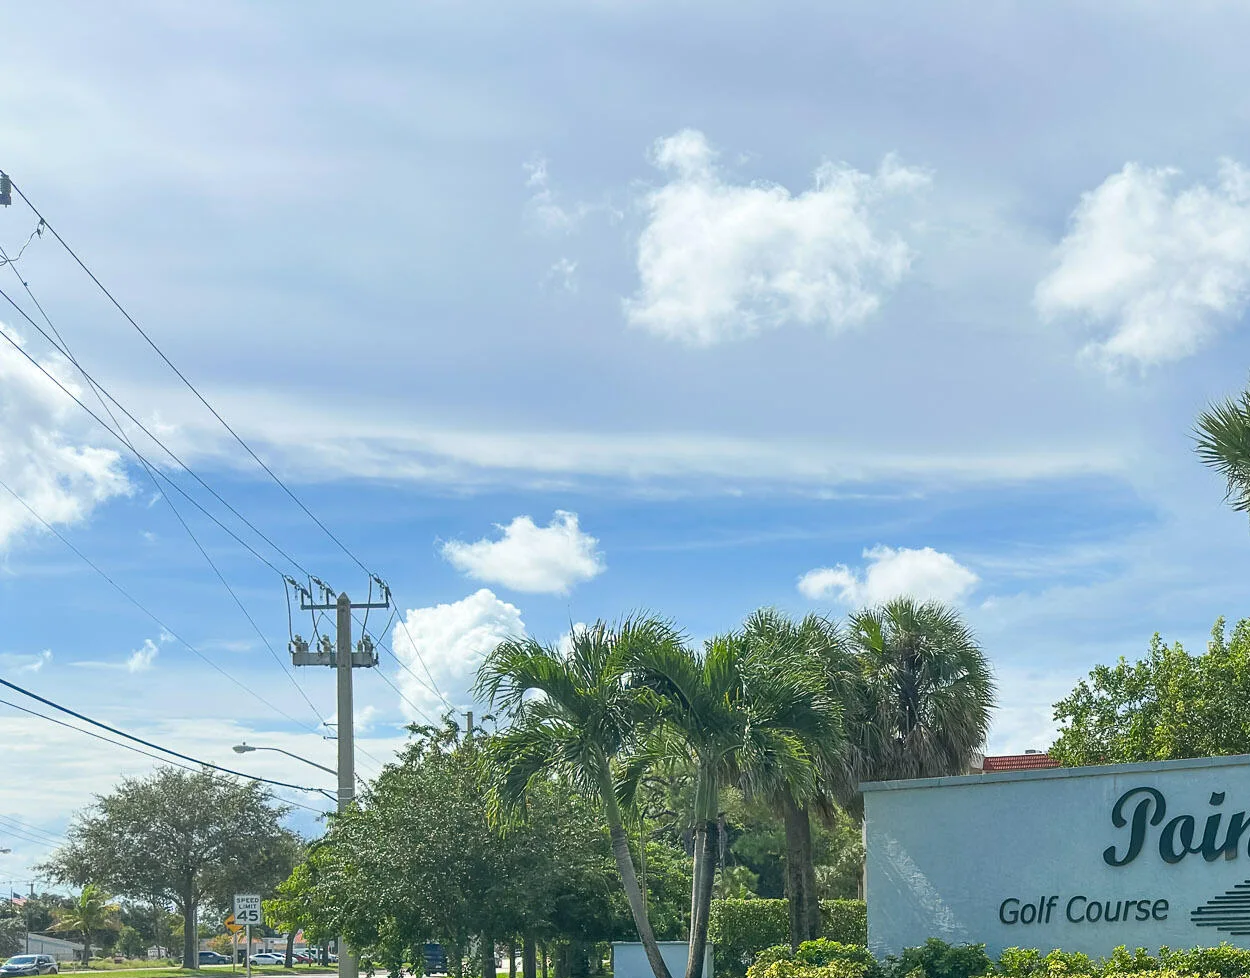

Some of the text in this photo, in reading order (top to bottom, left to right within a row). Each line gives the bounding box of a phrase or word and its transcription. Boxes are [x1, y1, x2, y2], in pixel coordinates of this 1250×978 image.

[236, 910, 259, 922] 45
[998, 895, 1170, 926] Golf Course
